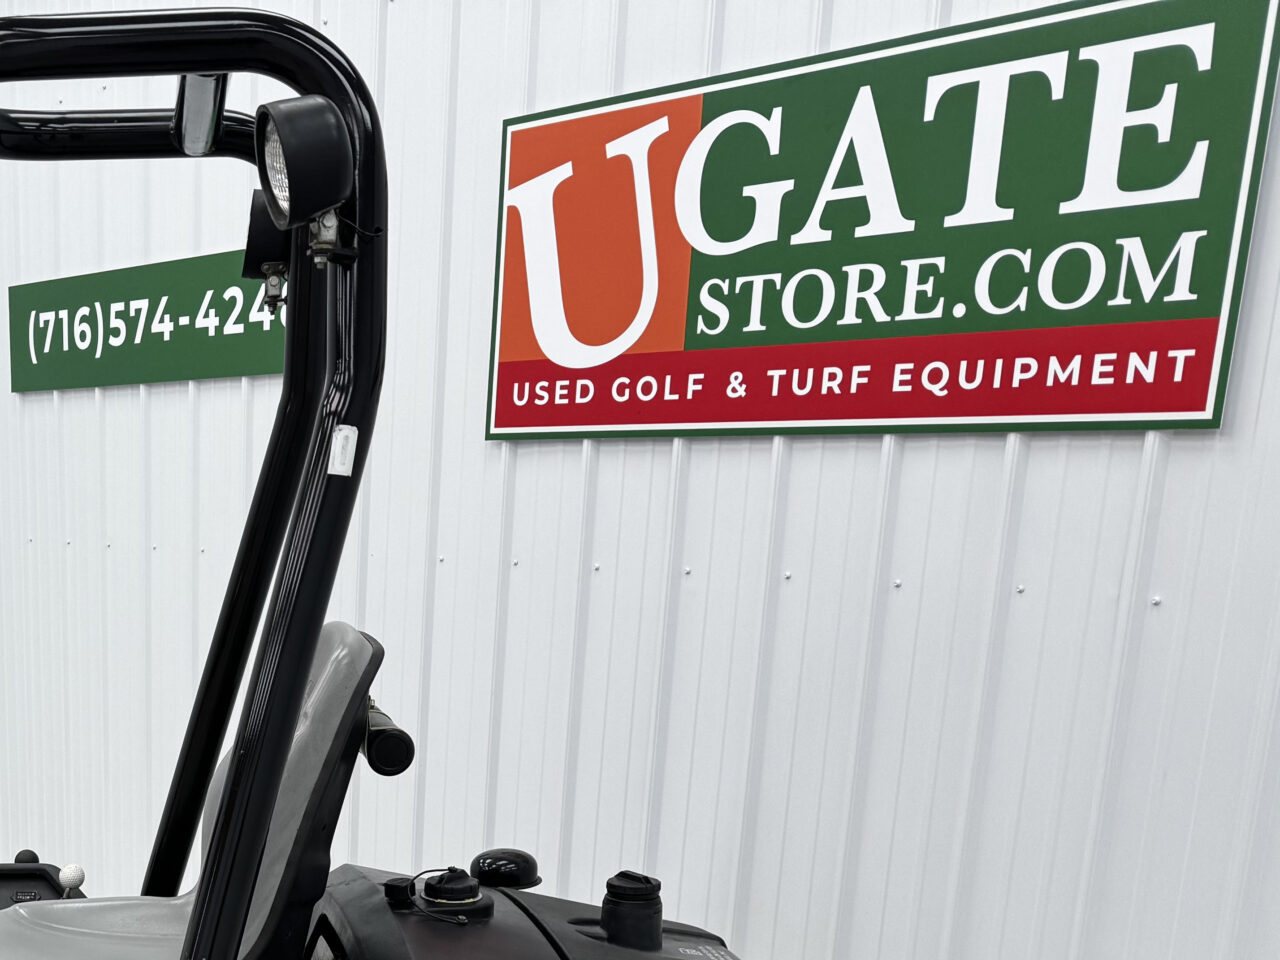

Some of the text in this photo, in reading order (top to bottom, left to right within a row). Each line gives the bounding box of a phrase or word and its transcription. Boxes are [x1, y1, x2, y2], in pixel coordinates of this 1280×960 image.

[696, 230, 1209, 336] STORE.COM
[512, 348, 1197, 406] USED GOLF & TURF EQUIPMENT
